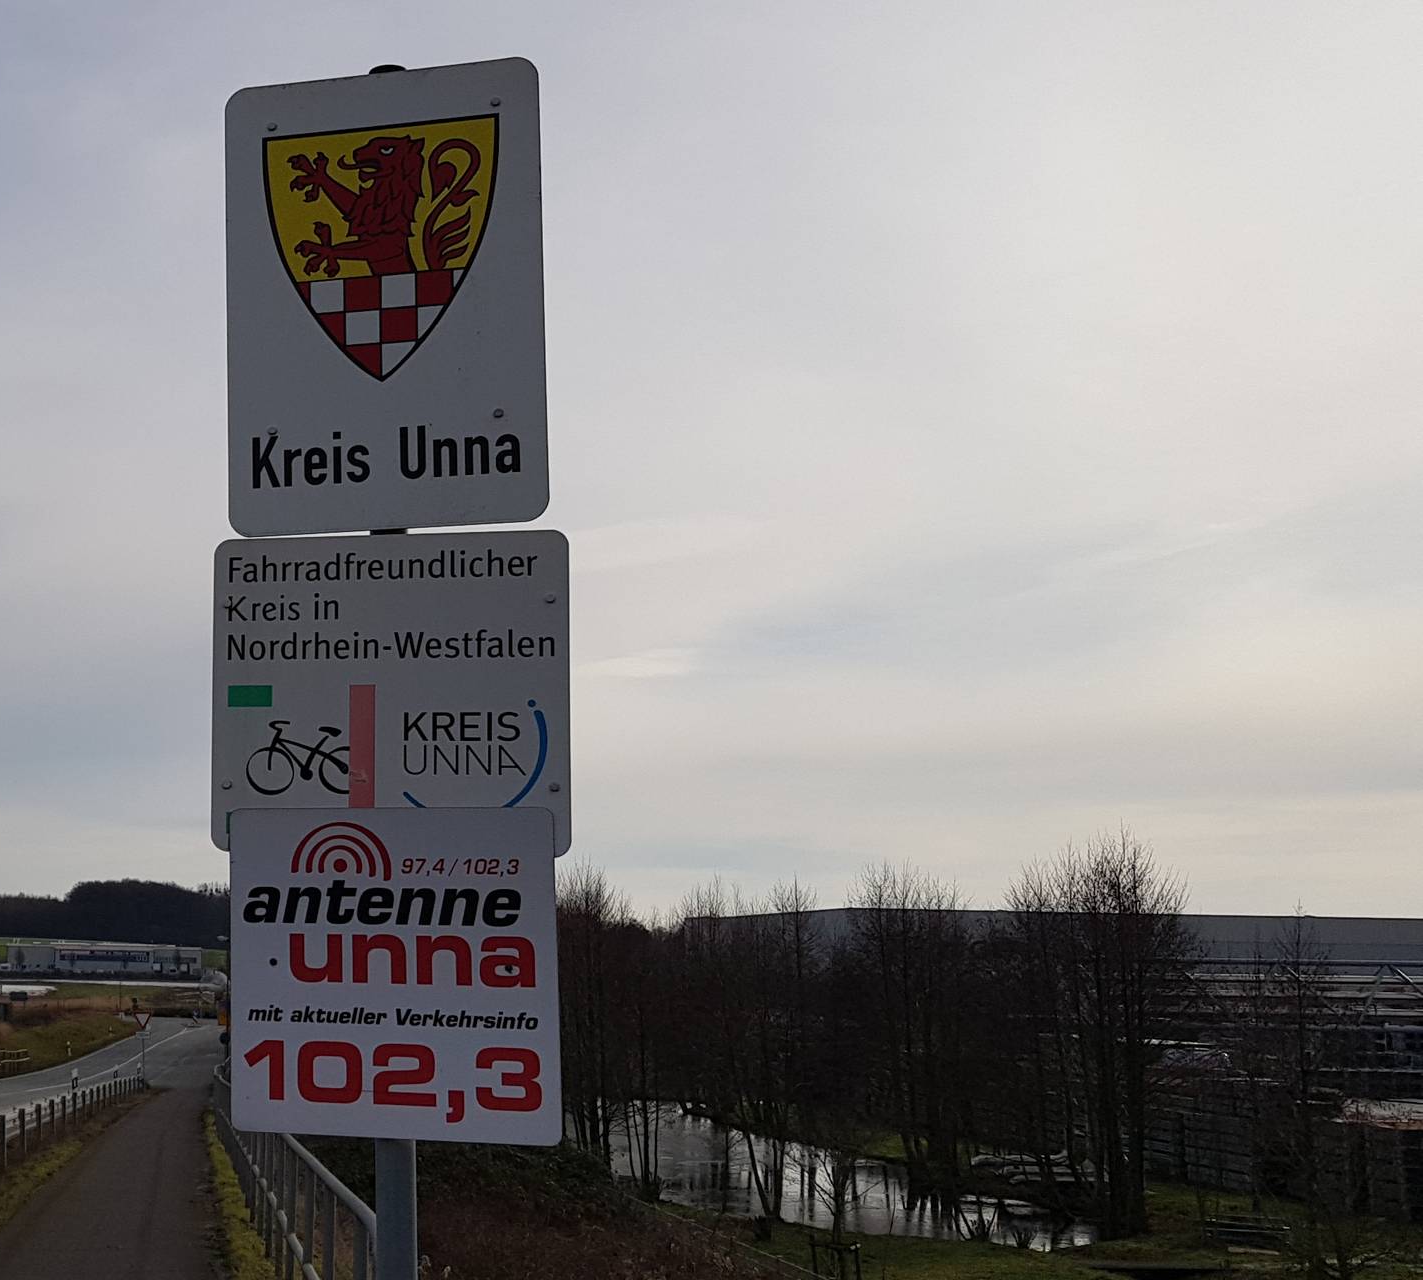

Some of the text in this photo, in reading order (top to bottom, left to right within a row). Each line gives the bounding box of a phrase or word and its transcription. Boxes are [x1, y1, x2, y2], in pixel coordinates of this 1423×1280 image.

[251, 425, 522, 489] Kreis Unna
[228, 549, 538, 583] Fahrradfreundlicher
[227, 593, 340, 622] Kreis in
[226, 629, 556, 661] Nordrhein-Westfalen
[403, 711, 521, 742] KREIS
[403, 743, 527, 776] UNNA
[242, 879, 522, 927] antenne
[289, 933, 537, 988] unna
[248, 1005, 539, 1031] mit aktueller Verkehrsinfo
[243, 1039, 543, 1124] 102,3
